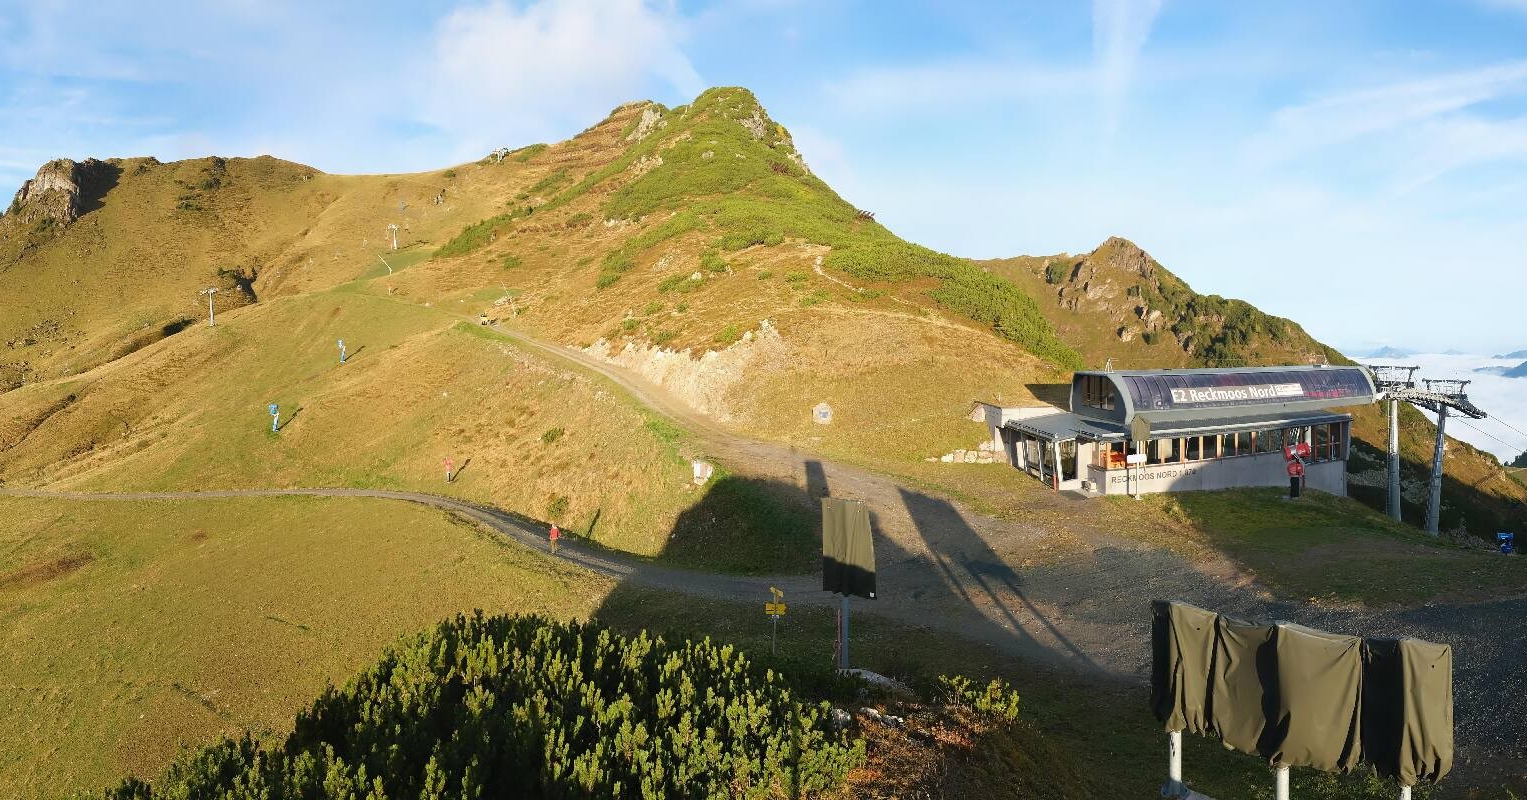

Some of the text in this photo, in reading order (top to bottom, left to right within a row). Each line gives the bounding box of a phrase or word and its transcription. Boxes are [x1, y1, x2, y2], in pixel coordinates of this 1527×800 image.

[1190, 385, 1247, 401] Reckmoos
[1249, 384, 1274, 399] Nord
[1156, 469, 1178, 479] NORD
